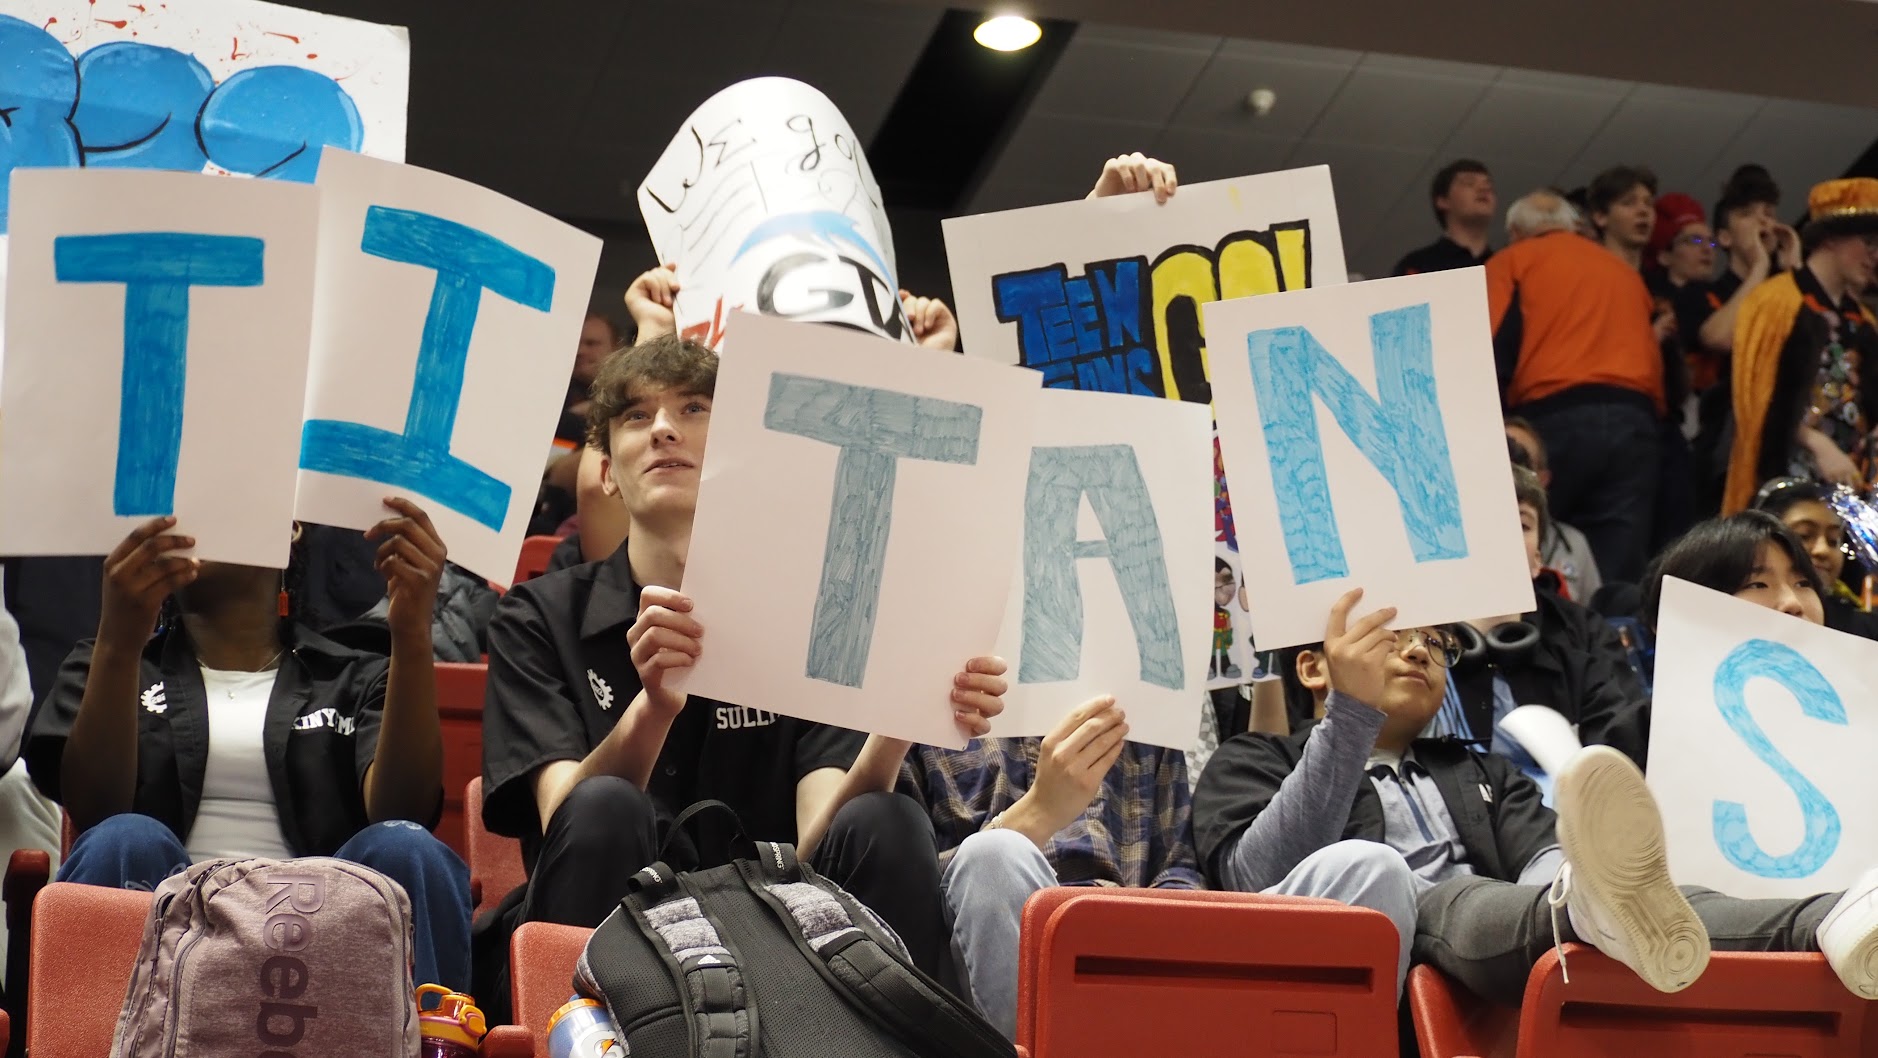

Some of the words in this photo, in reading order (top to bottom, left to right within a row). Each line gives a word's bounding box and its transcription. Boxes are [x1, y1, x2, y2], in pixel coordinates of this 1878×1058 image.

[54, 232, 265, 517] T
[298, 205, 556, 533] I
[991, 255, 1150, 367] TEEN
[763, 371, 983, 690] T
[1018, 444, 1185, 690] A
[1247, 303, 1467, 585] N
[1712, 638, 1849, 879] S
[256, 874, 325, 1058] Reeb
